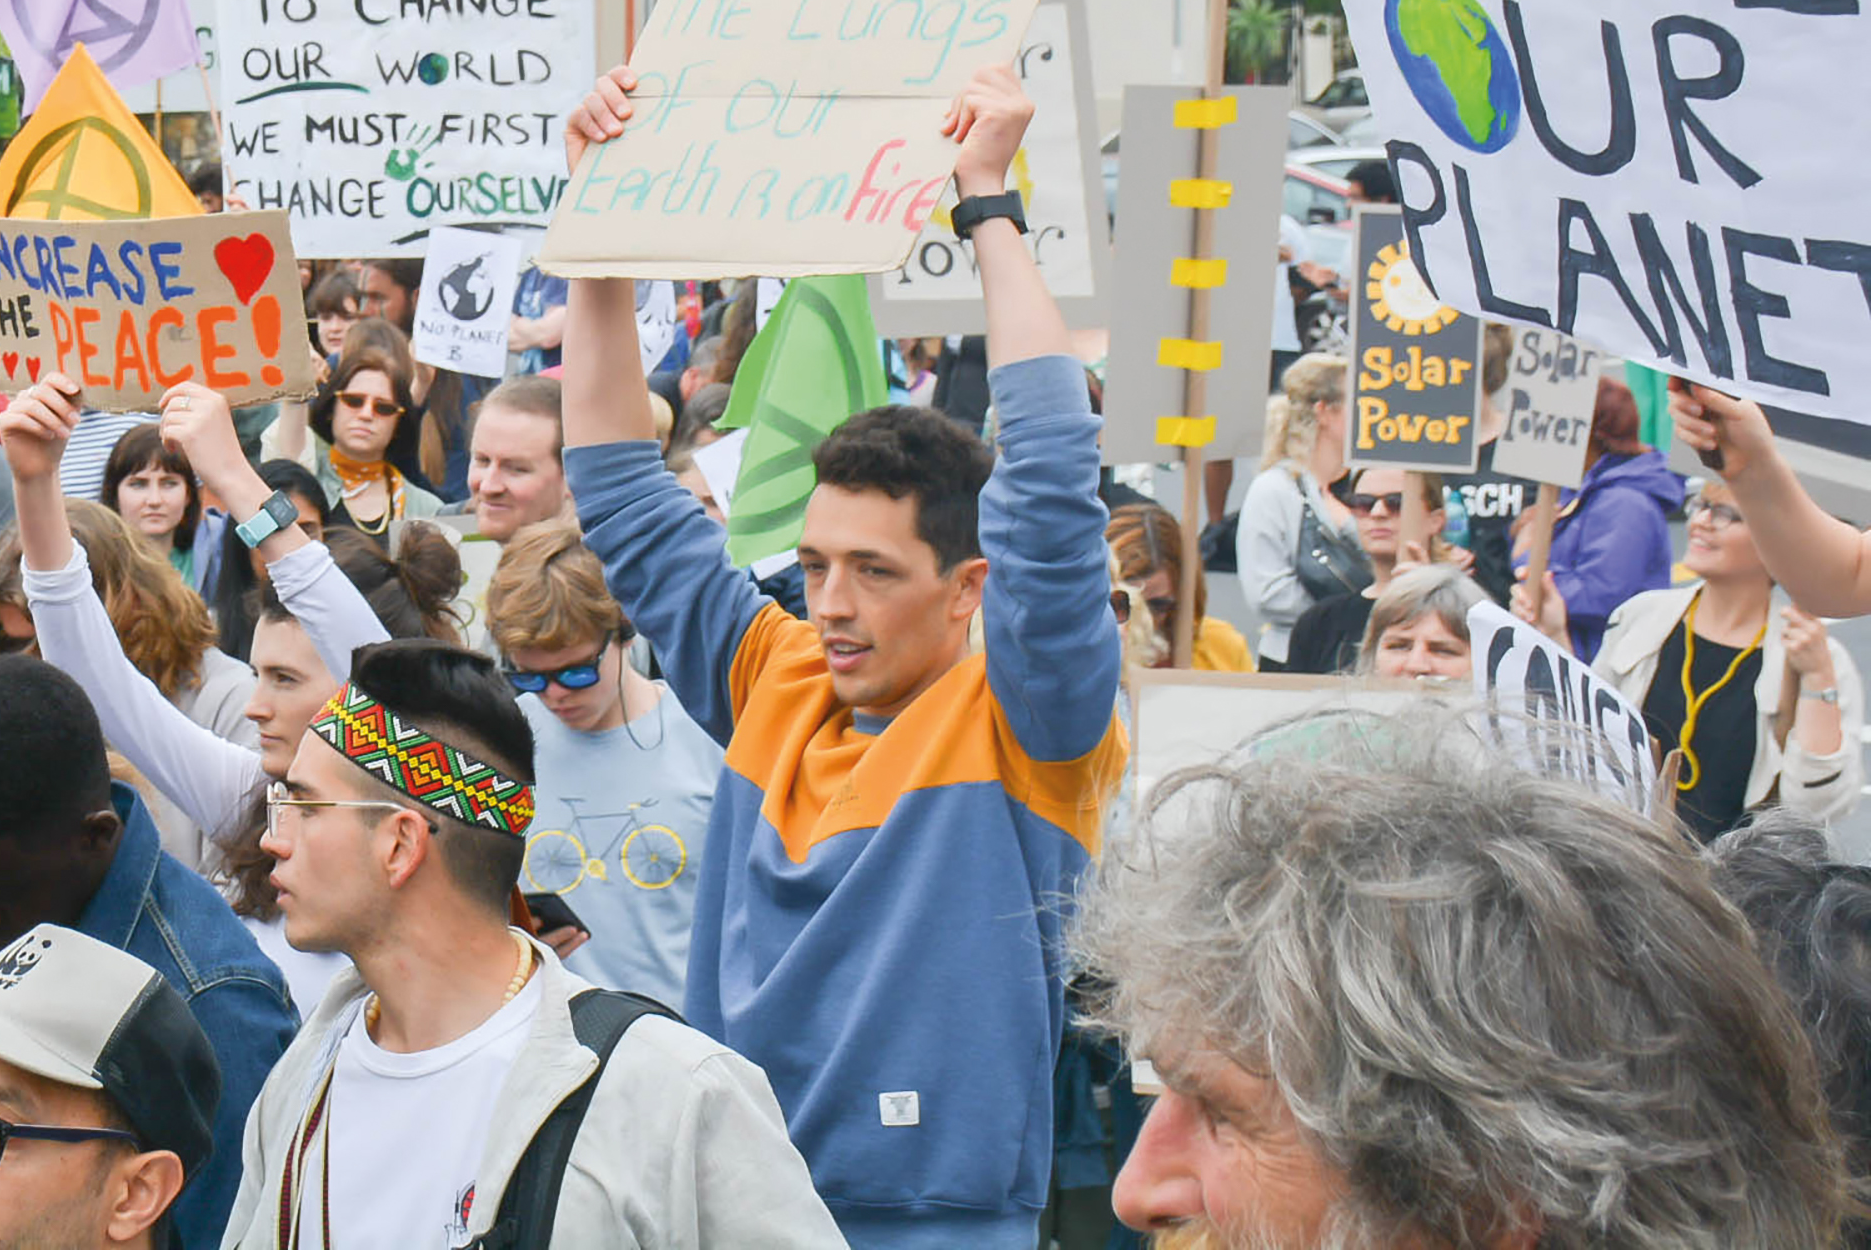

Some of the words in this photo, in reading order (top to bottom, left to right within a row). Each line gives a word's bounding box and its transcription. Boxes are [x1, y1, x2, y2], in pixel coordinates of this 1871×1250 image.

[242, 41, 332, 84] OUR
[376, 50, 552, 86] WORLD
[230, 120, 280, 158] WE
[304, 113, 407, 147] MUST
[437, 113, 558, 146] FIRST
[49, 294, 285, 393] PEACE!
[1358, 346, 1472, 391] Solar
[1516, 330, 1598, 385] Solar
[1356, 396, 1471, 450] Power
[1503, 387, 1589, 447] Power
